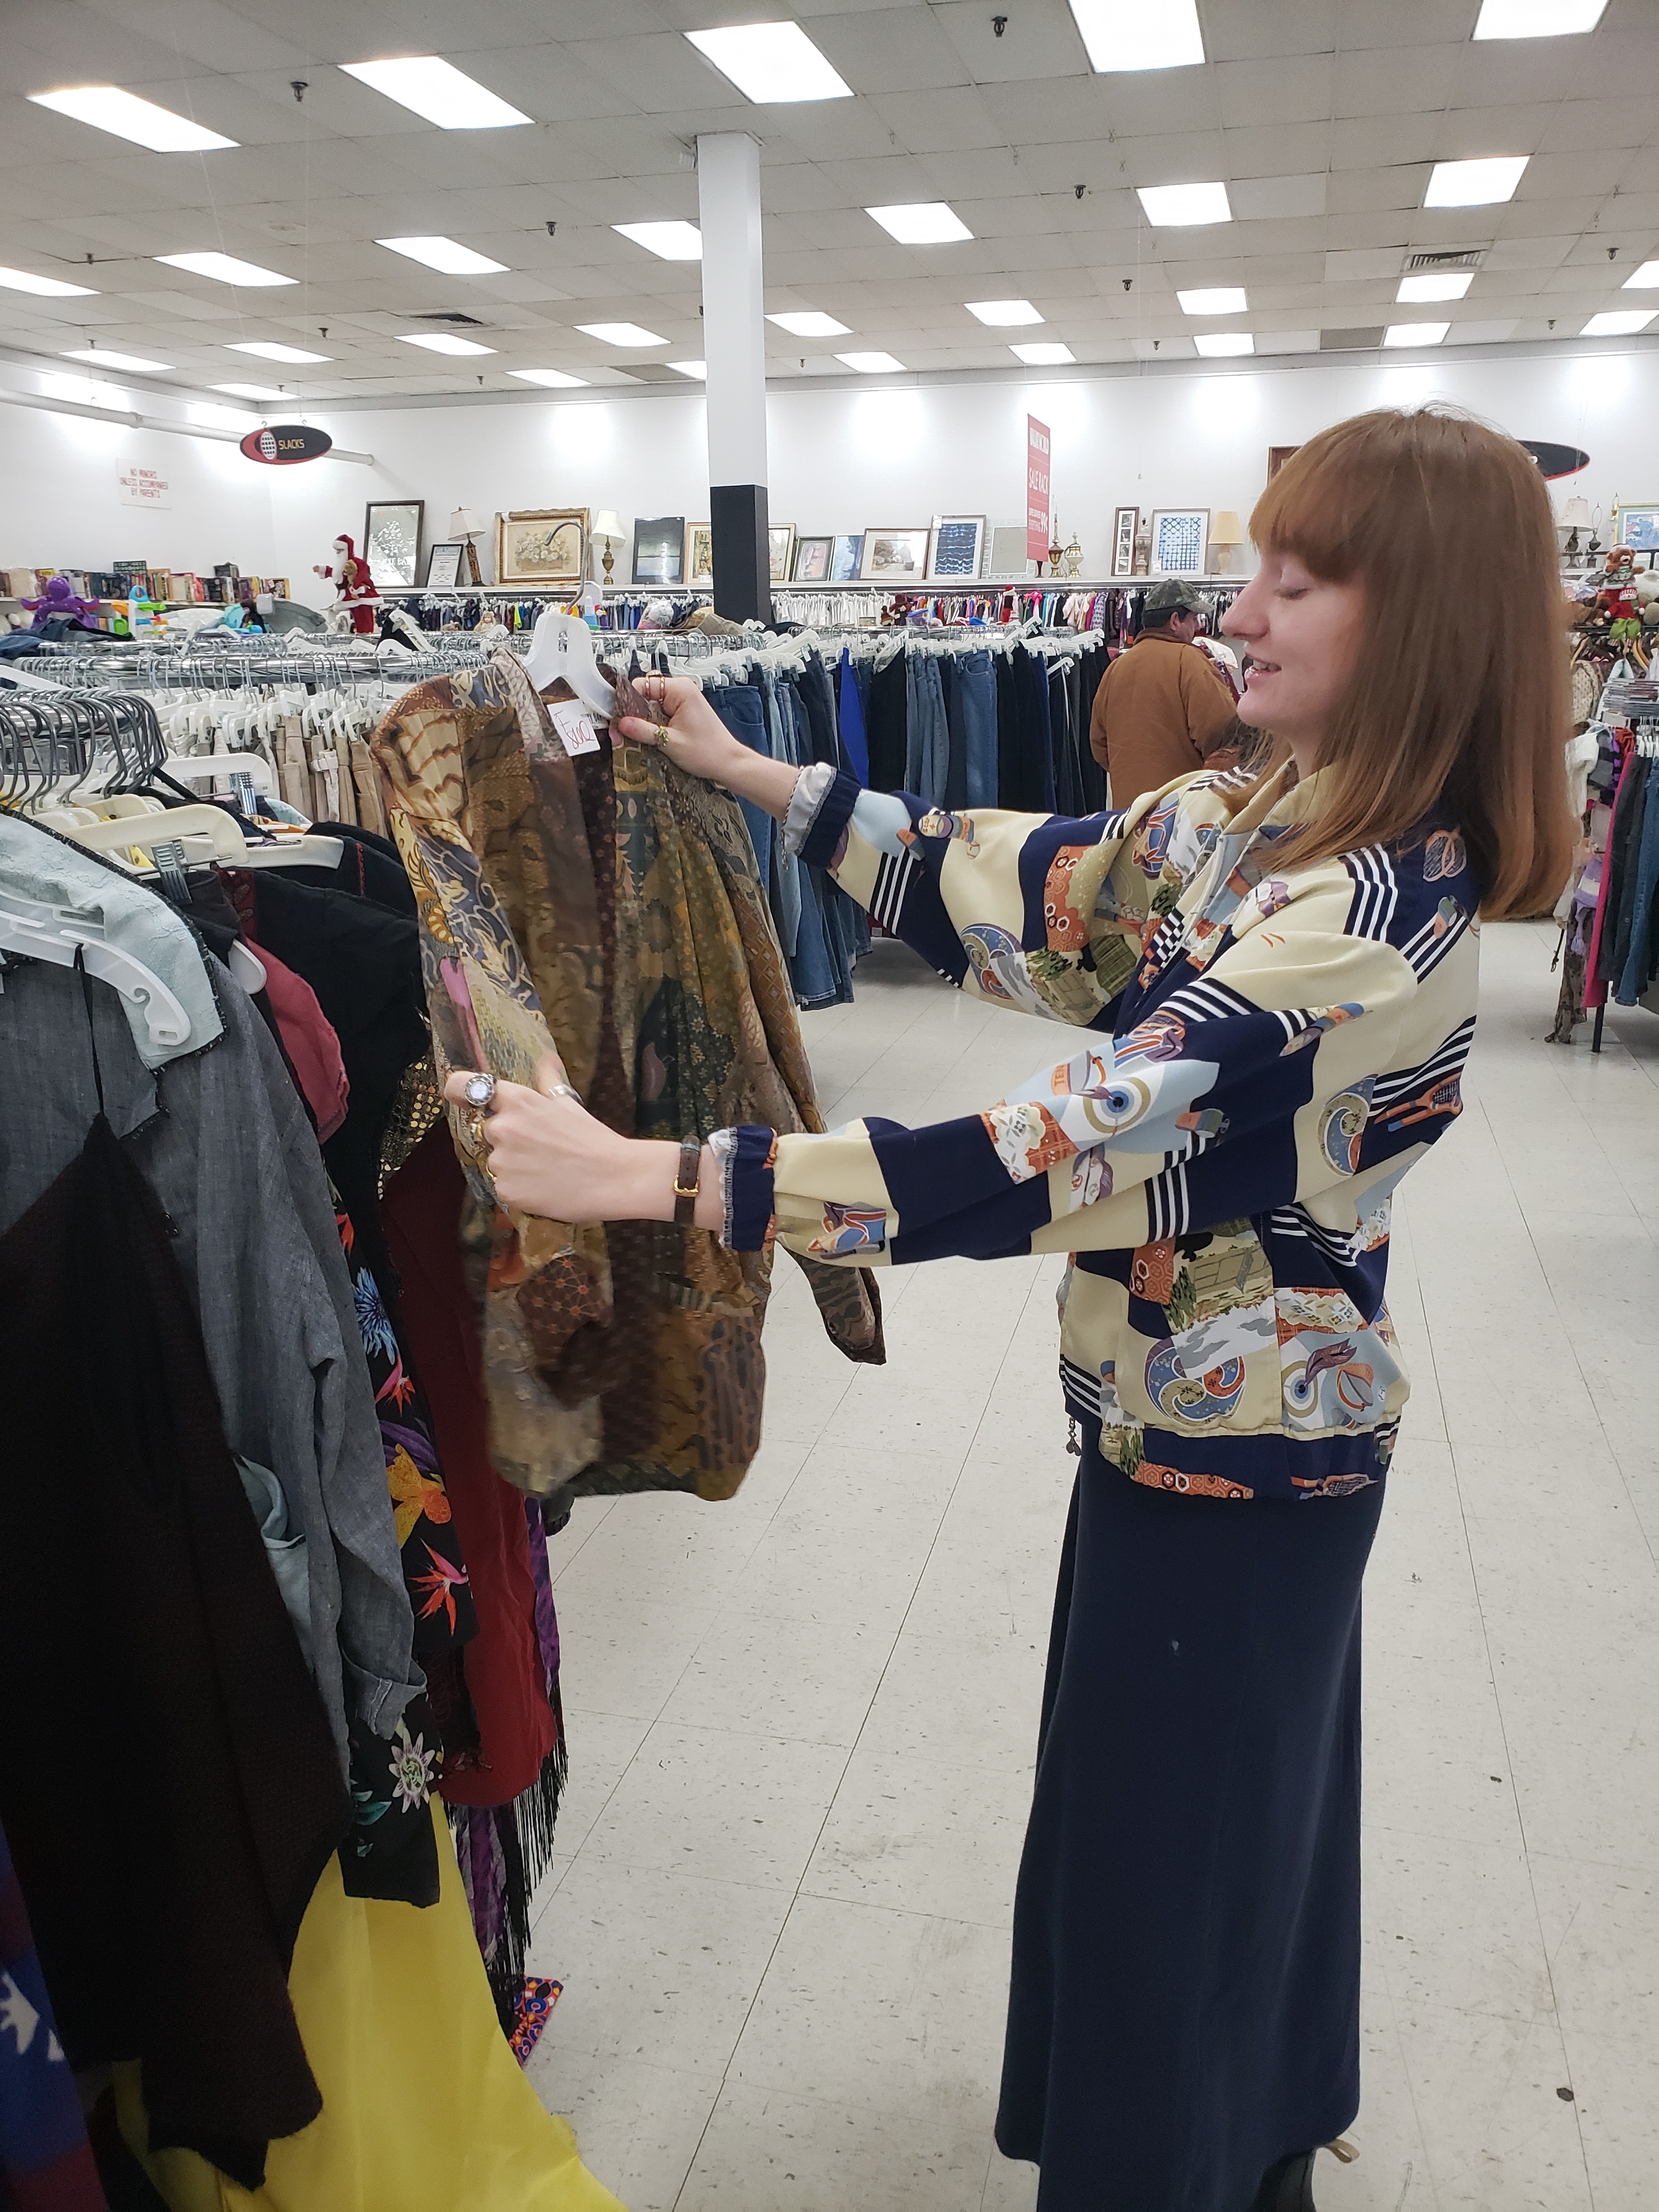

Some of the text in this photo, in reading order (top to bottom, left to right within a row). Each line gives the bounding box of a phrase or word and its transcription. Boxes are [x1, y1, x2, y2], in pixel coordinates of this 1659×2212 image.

[278, 439, 305, 450] SLACKS
[1029, 467, 1048, 495] SALE RACK
